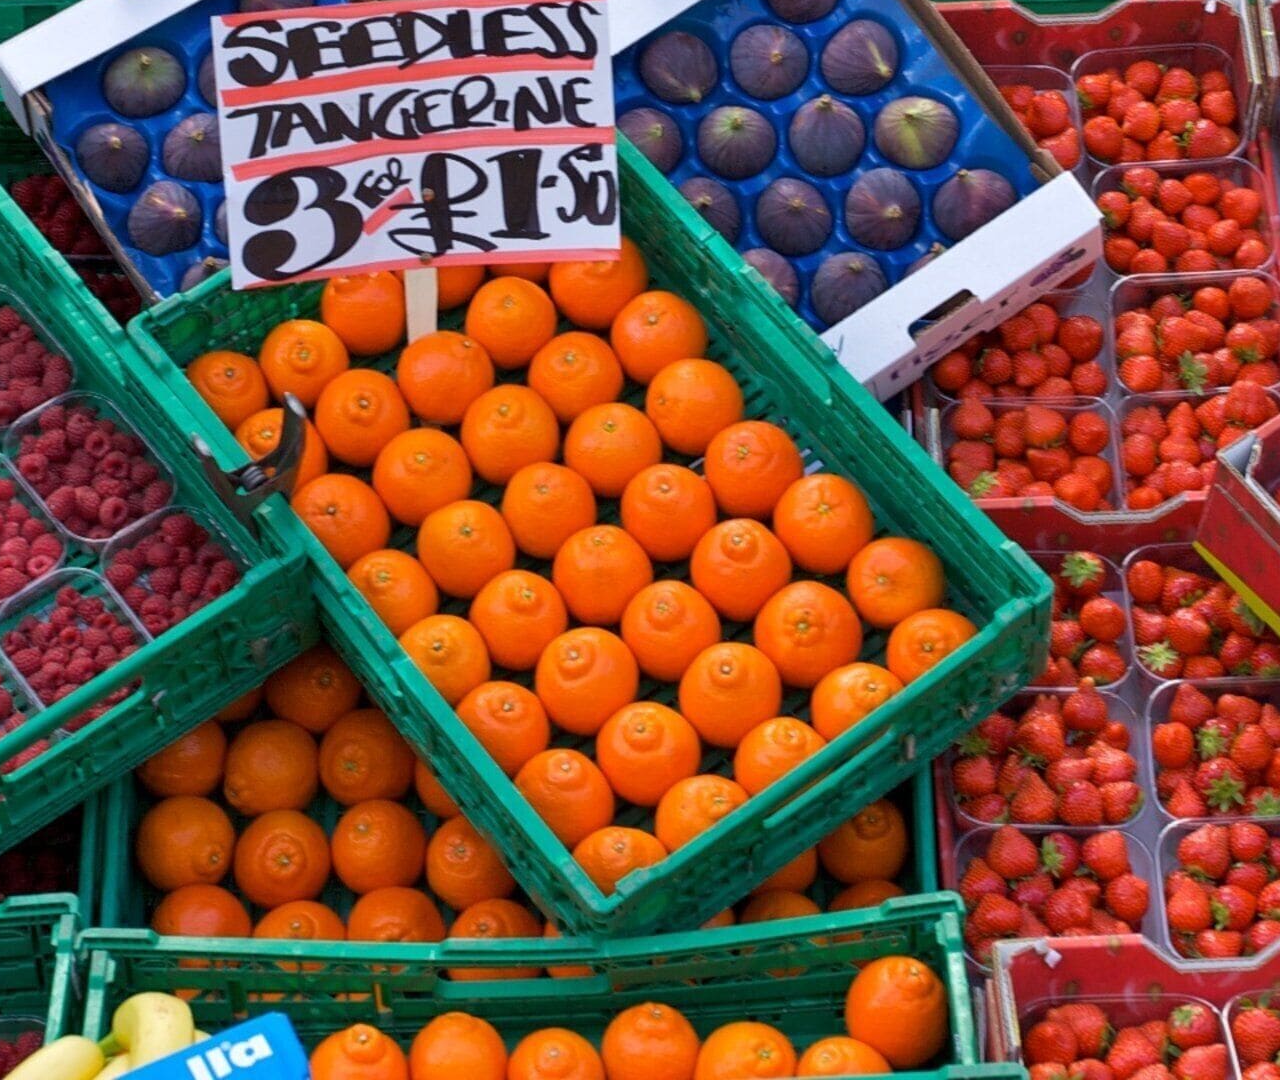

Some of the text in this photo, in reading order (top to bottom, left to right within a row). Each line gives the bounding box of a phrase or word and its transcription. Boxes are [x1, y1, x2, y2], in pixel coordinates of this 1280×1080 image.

[223, 0, 603, 88] SEEDLESS
[226, 75, 598, 160] TANGERINE
[242, 166, 365, 283] 3
[354, 156, 414, 211] FOR
